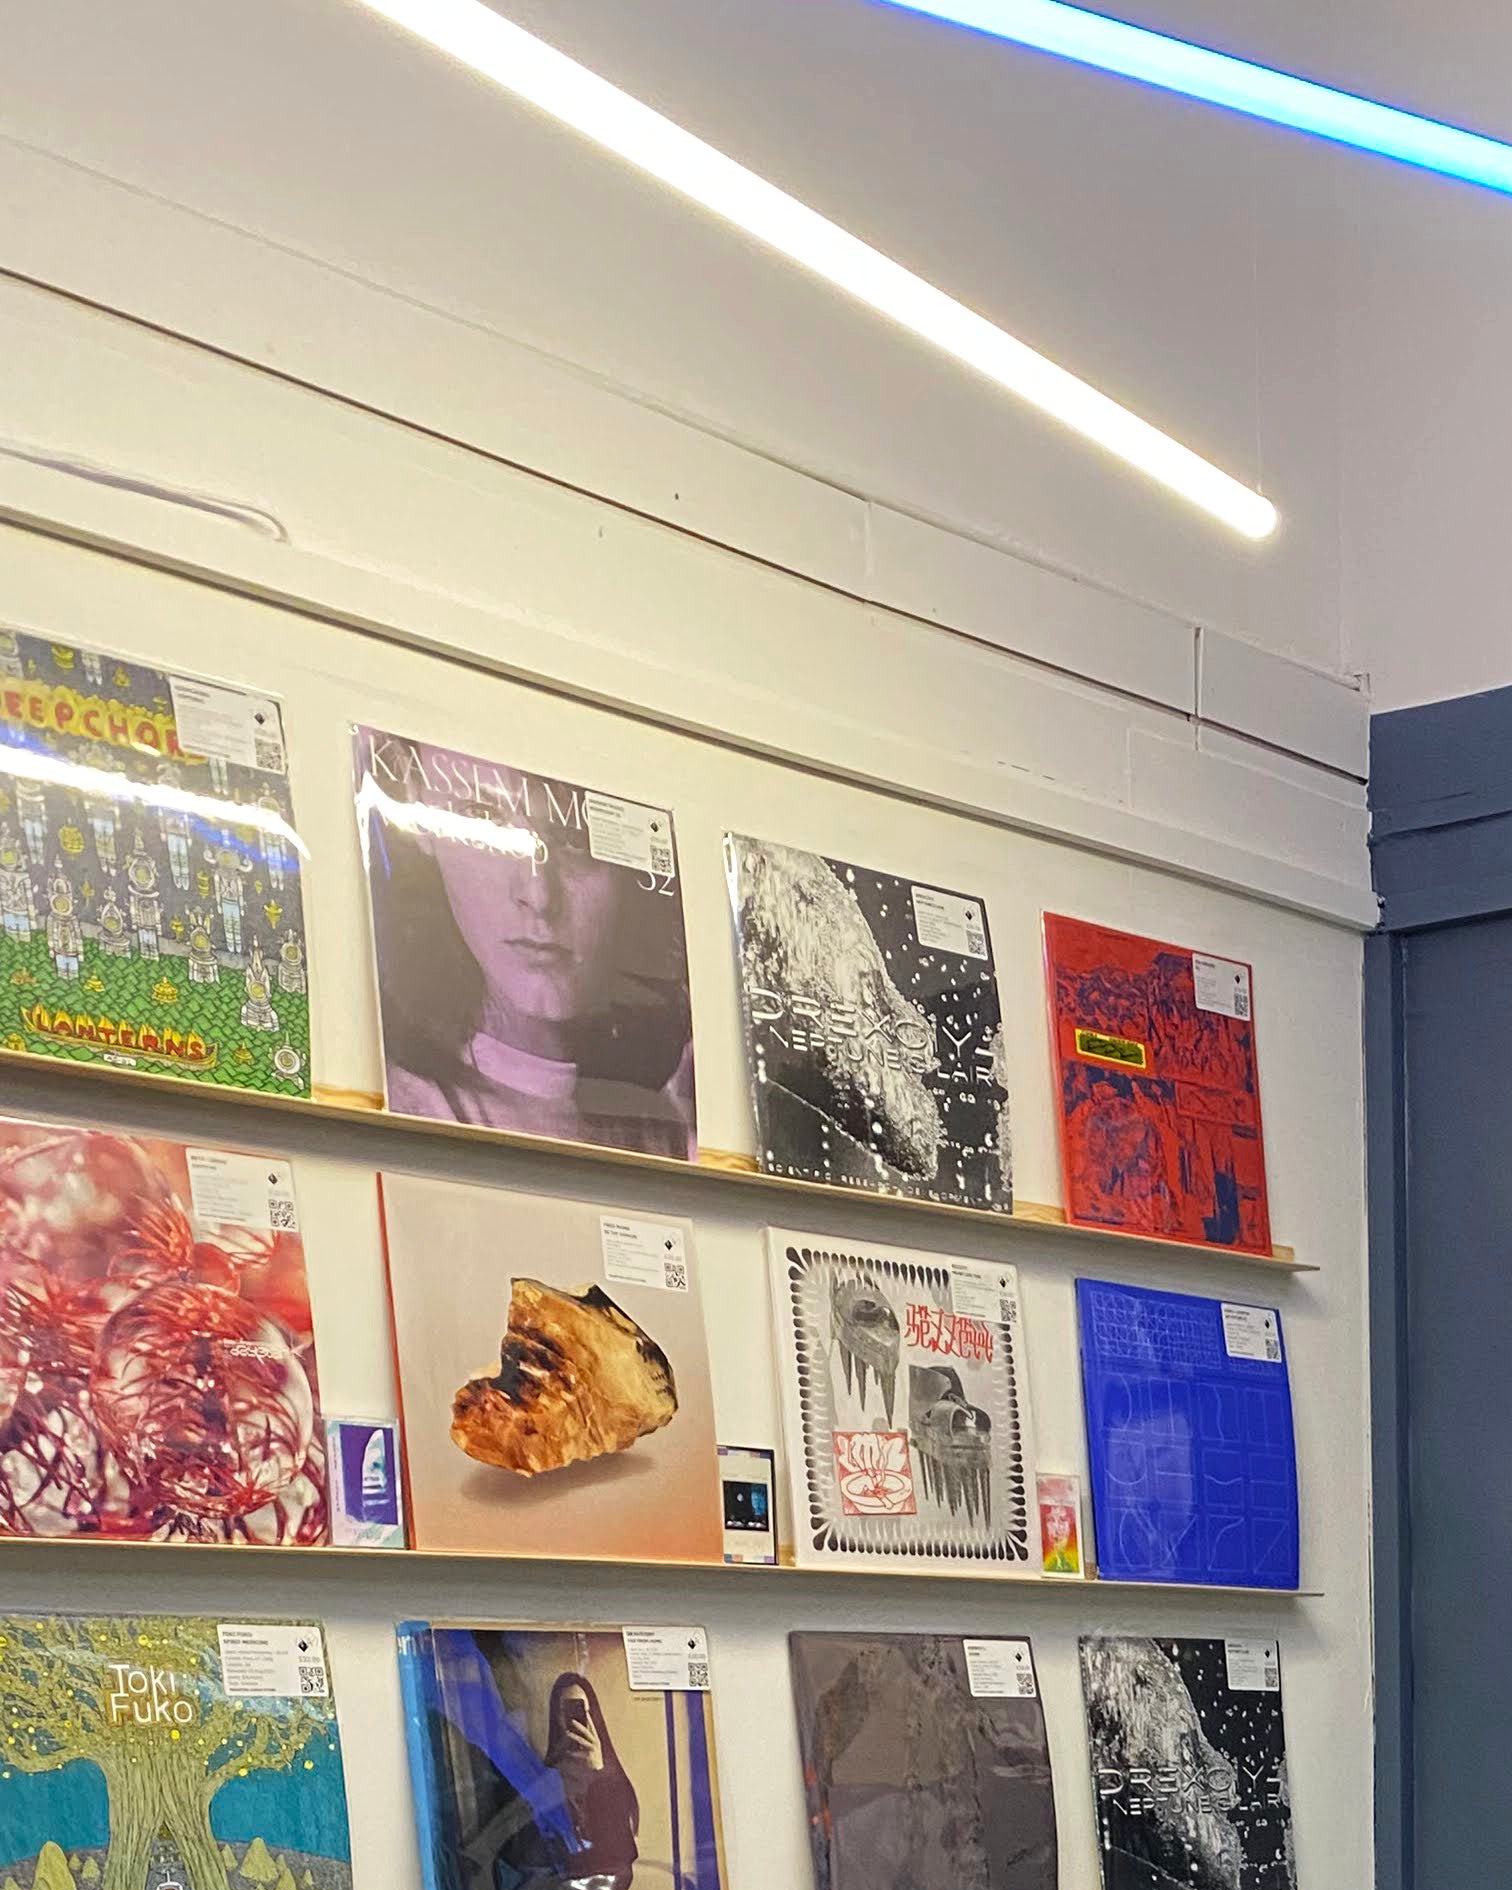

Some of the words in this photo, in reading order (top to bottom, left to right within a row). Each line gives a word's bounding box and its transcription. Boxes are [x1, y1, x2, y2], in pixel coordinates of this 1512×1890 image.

[370, 735, 531, 816] KASSEM
[36, 1009, 204, 1061] LANTERNS
[108, 1664, 176, 1697] Toki
[110, 1692, 194, 1723] Fuko
